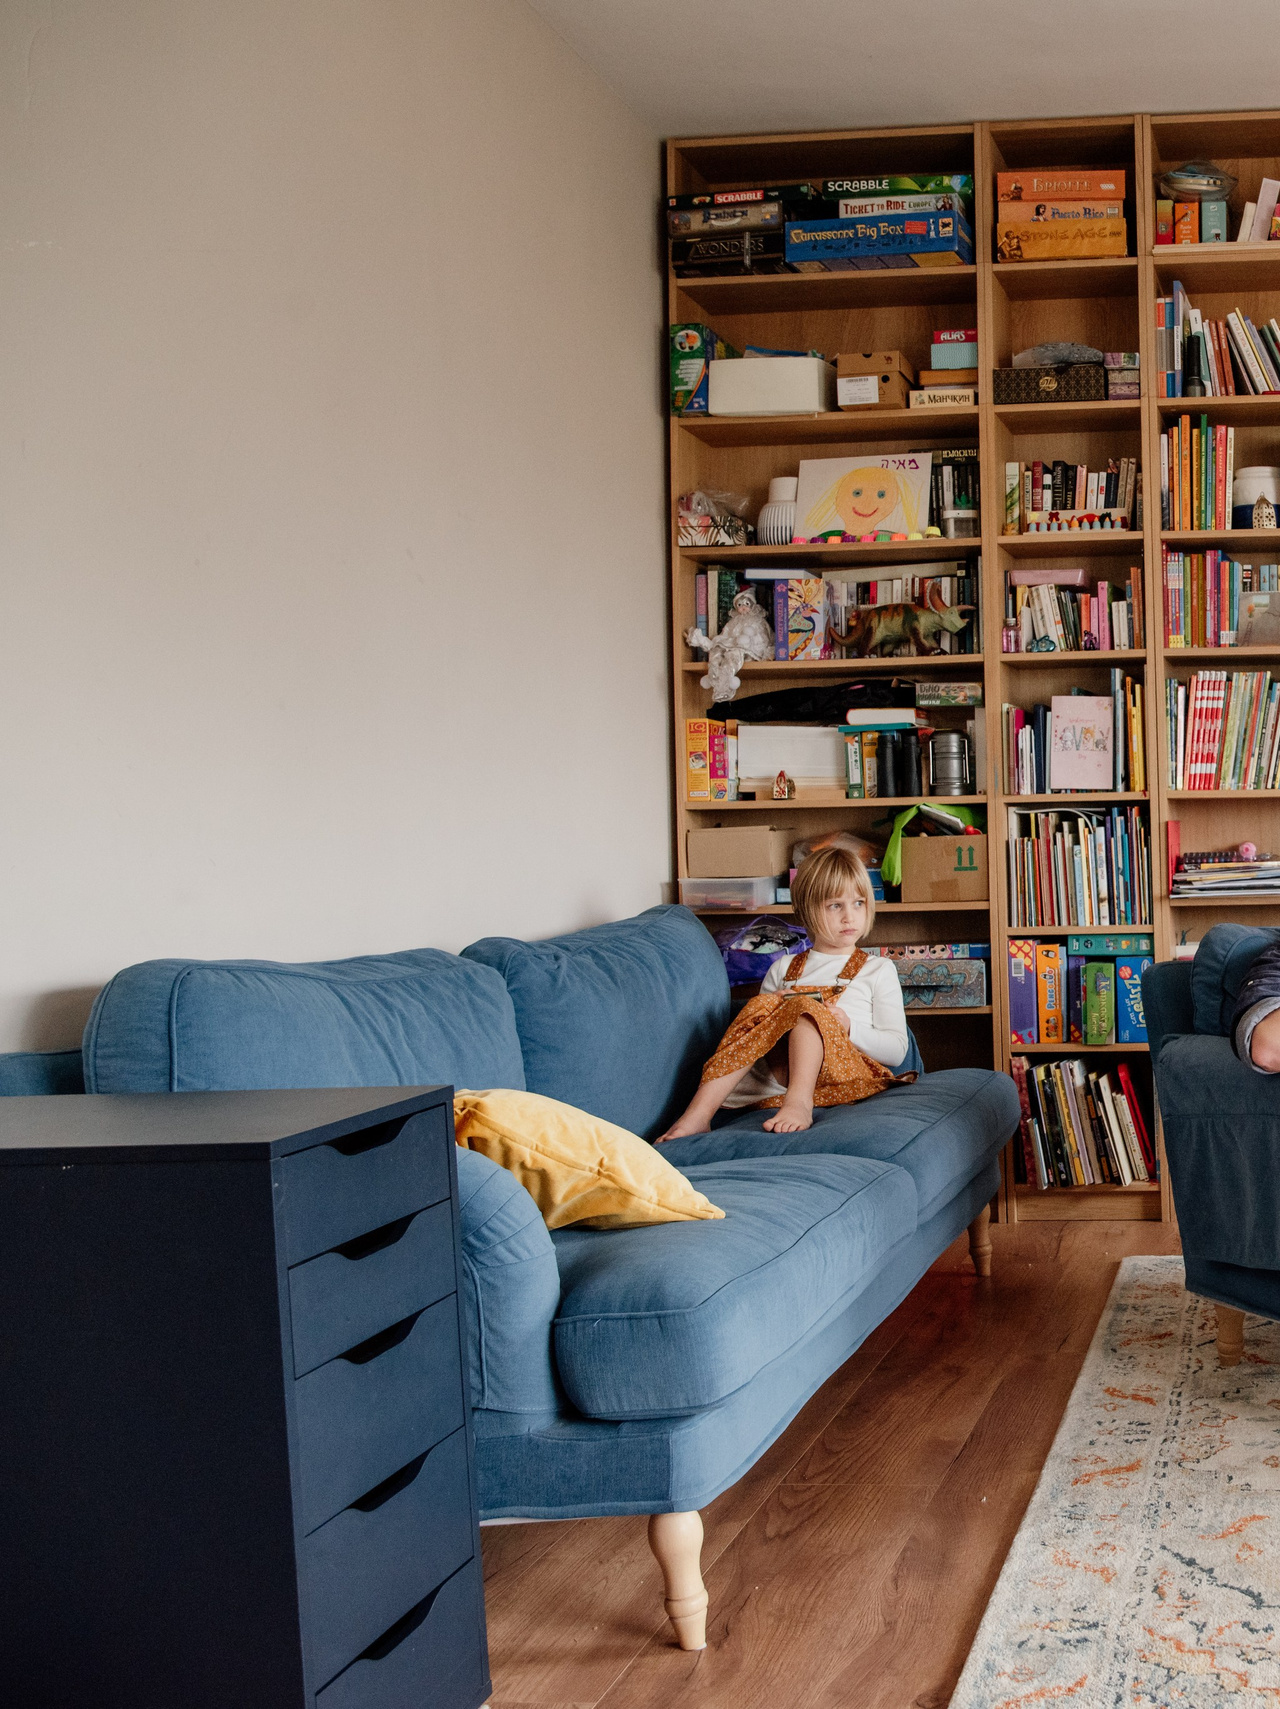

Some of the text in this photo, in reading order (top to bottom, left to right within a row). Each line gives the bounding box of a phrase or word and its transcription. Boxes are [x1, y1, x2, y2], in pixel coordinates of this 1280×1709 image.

[827, 179, 890, 192] SCRABBLE
[716, 191, 764, 203] SCRABBLE
[843, 203, 876, 215] TICKET
[886, 200, 907, 211] RIDE
[1051, 206, 1105, 219] Puerto Rico
[790, 222, 903, 243] Carcassonne Big Box
[1020, 229, 1069, 243] STONE
[1072, 227, 1108, 241] AGE
[927, 394, 971, 404] Манчкин
[880, 458, 920, 470] מאיה
[689, 722, 706, 733] IQ
